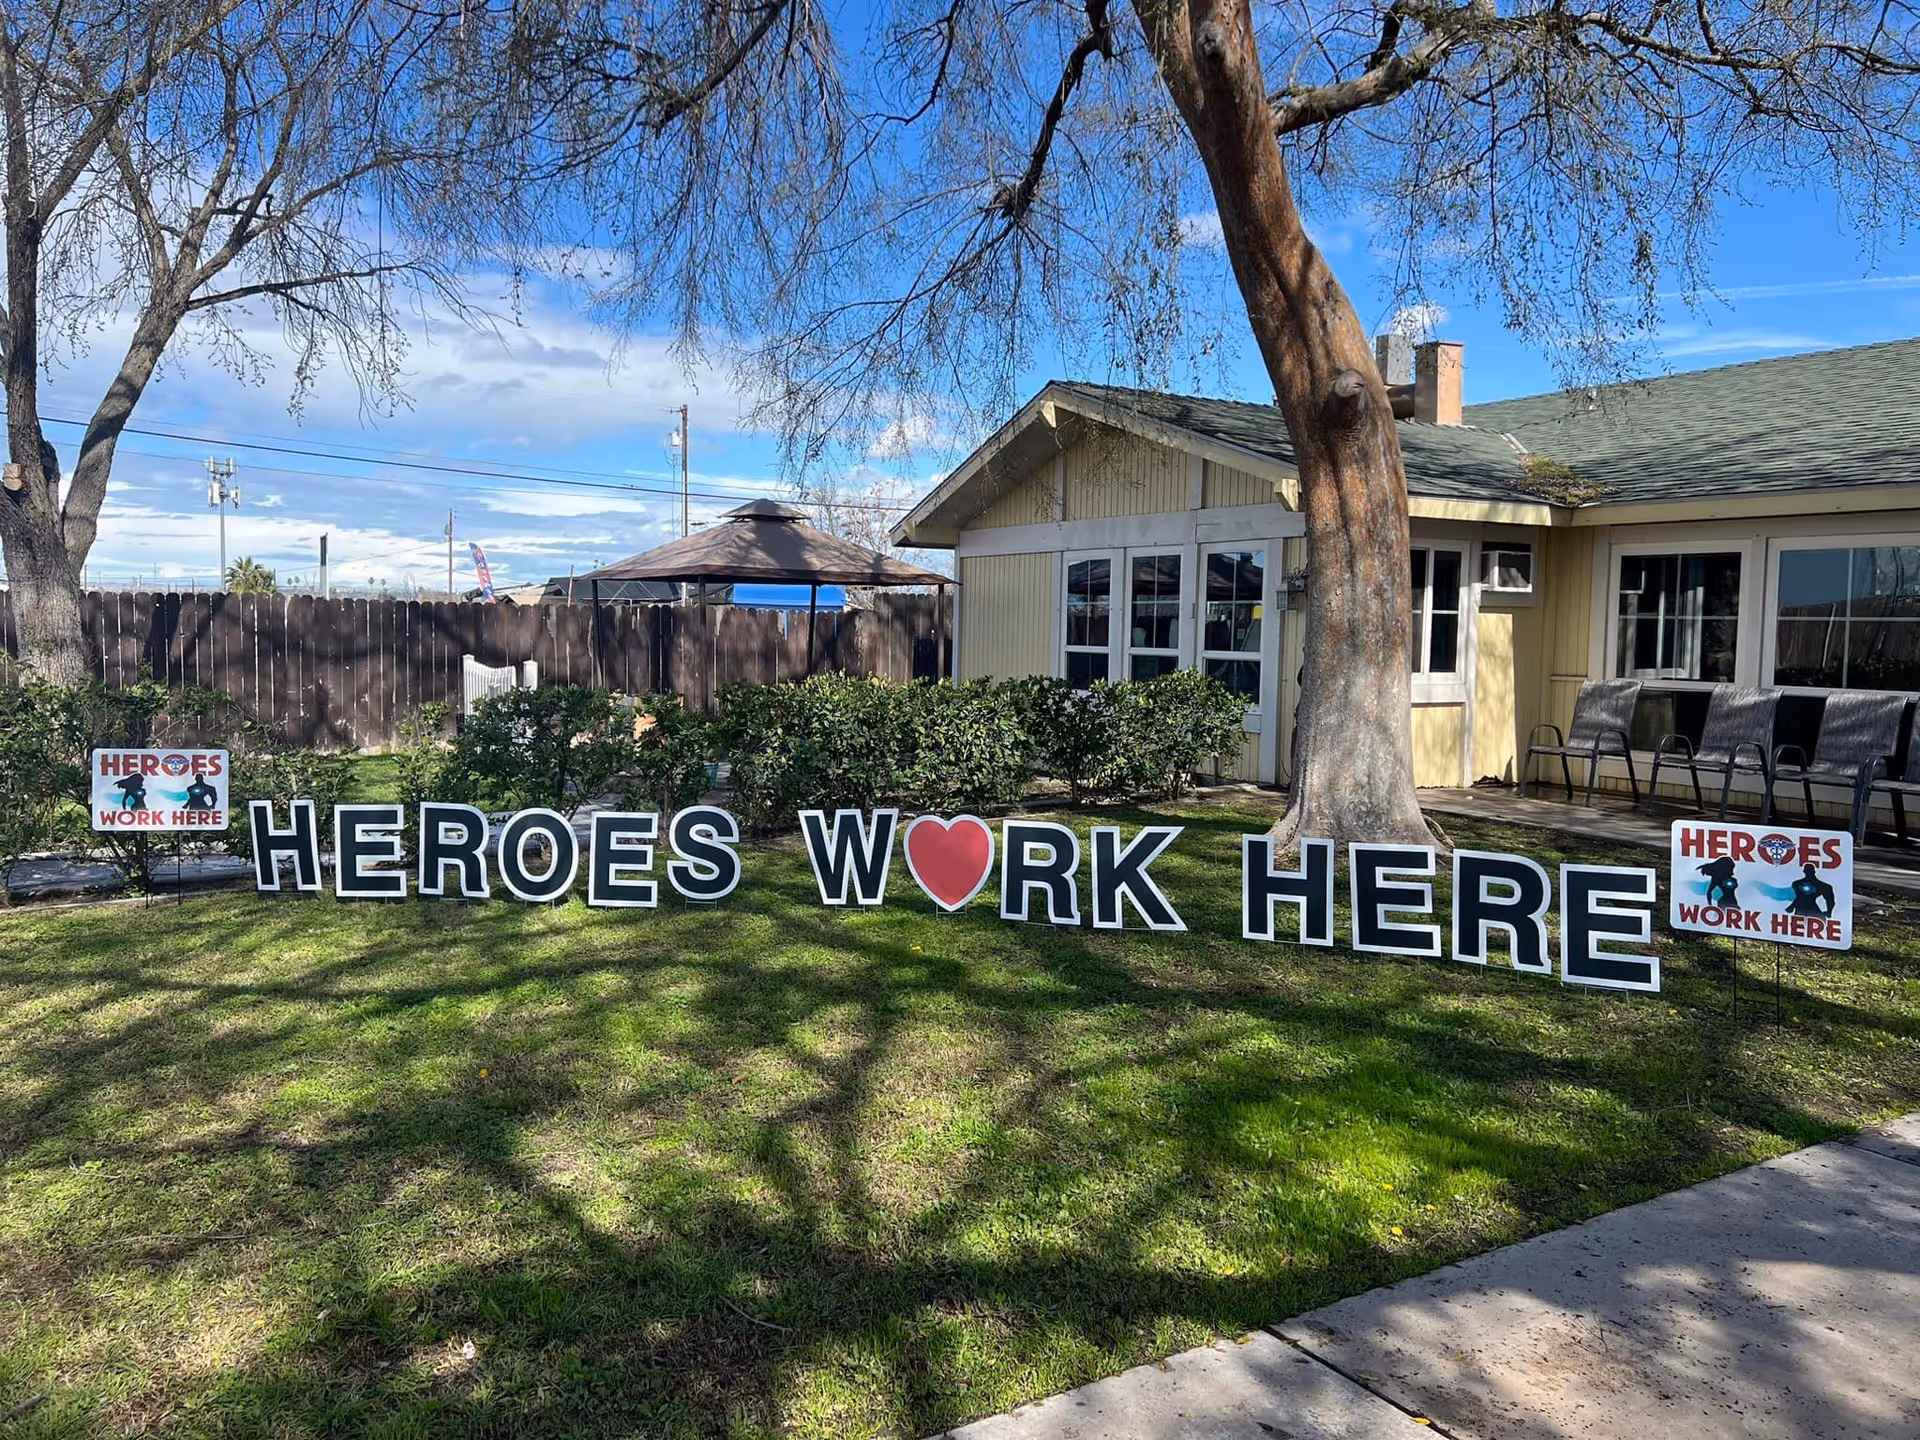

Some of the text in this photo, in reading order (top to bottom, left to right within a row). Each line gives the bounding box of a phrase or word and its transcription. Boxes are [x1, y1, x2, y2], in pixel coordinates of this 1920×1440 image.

[100, 753, 222, 777] HEROES
[100, 810, 222, 826] WORK HERE
[1680, 827, 1842, 869] HEROES
[248, 799, 1660, 992] HEROES WRK HERE
[1678, 902, 1841, 942] WORK HERE
